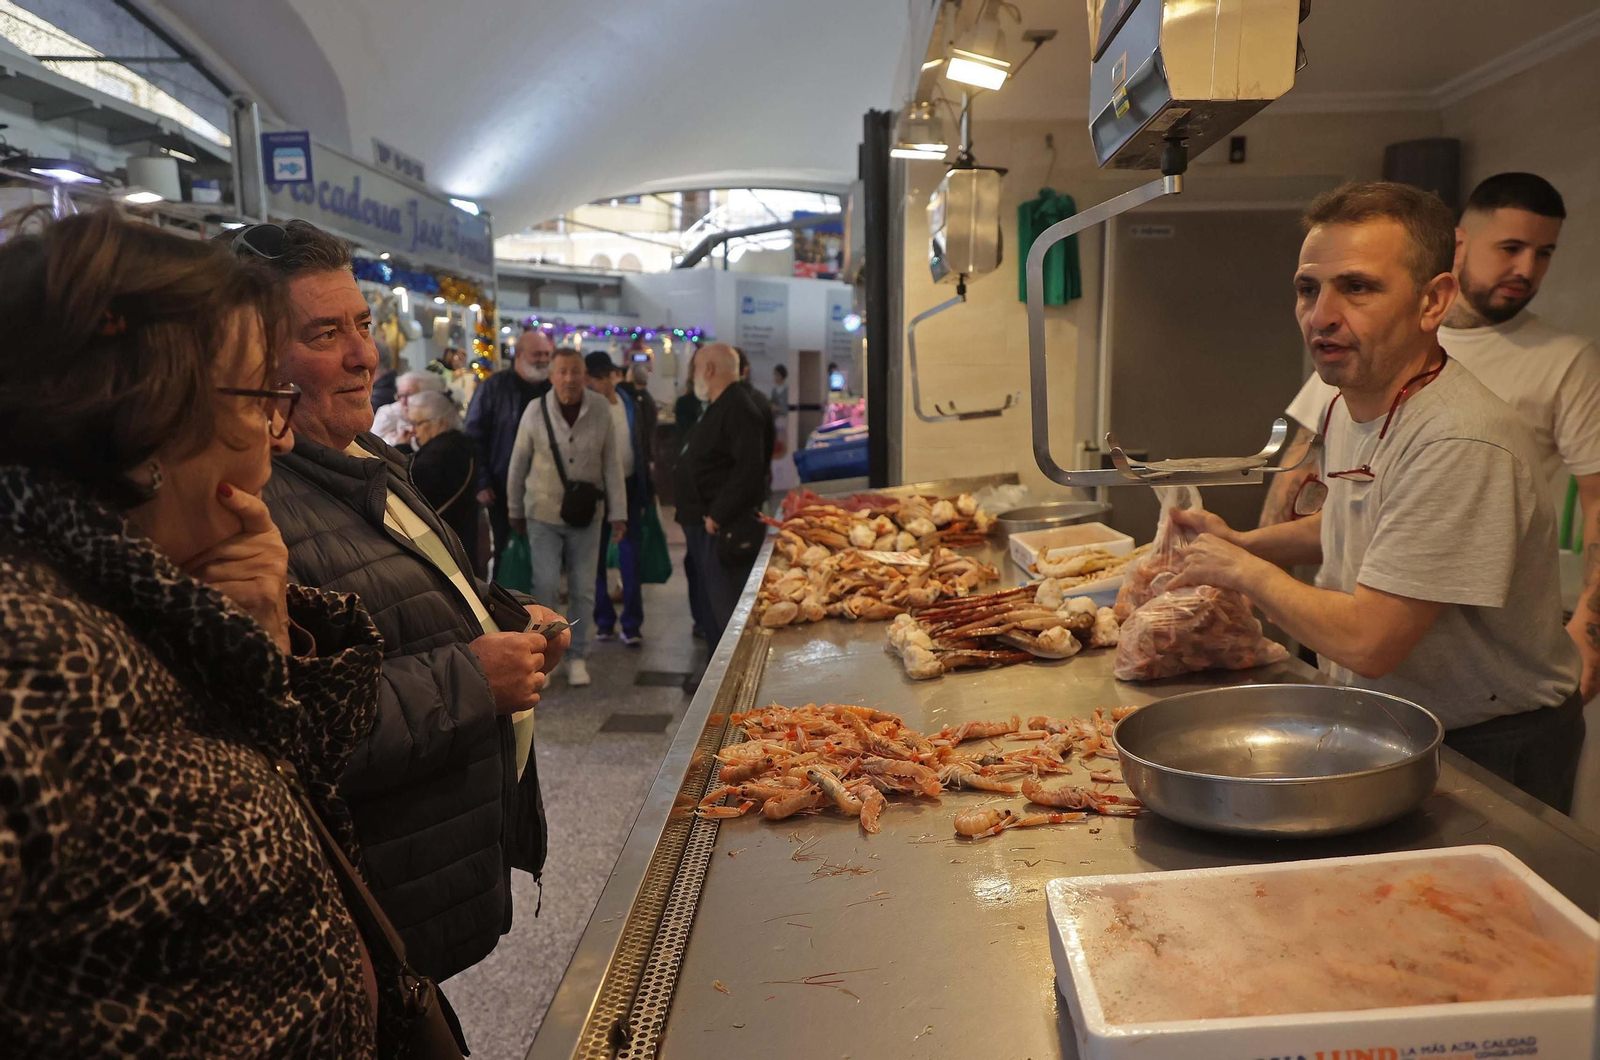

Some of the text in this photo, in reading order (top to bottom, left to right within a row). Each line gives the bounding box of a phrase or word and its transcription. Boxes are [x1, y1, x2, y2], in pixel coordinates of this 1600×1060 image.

[1400, 1036, 1537, 1056] LA MÁS ALTA CALIDAD
